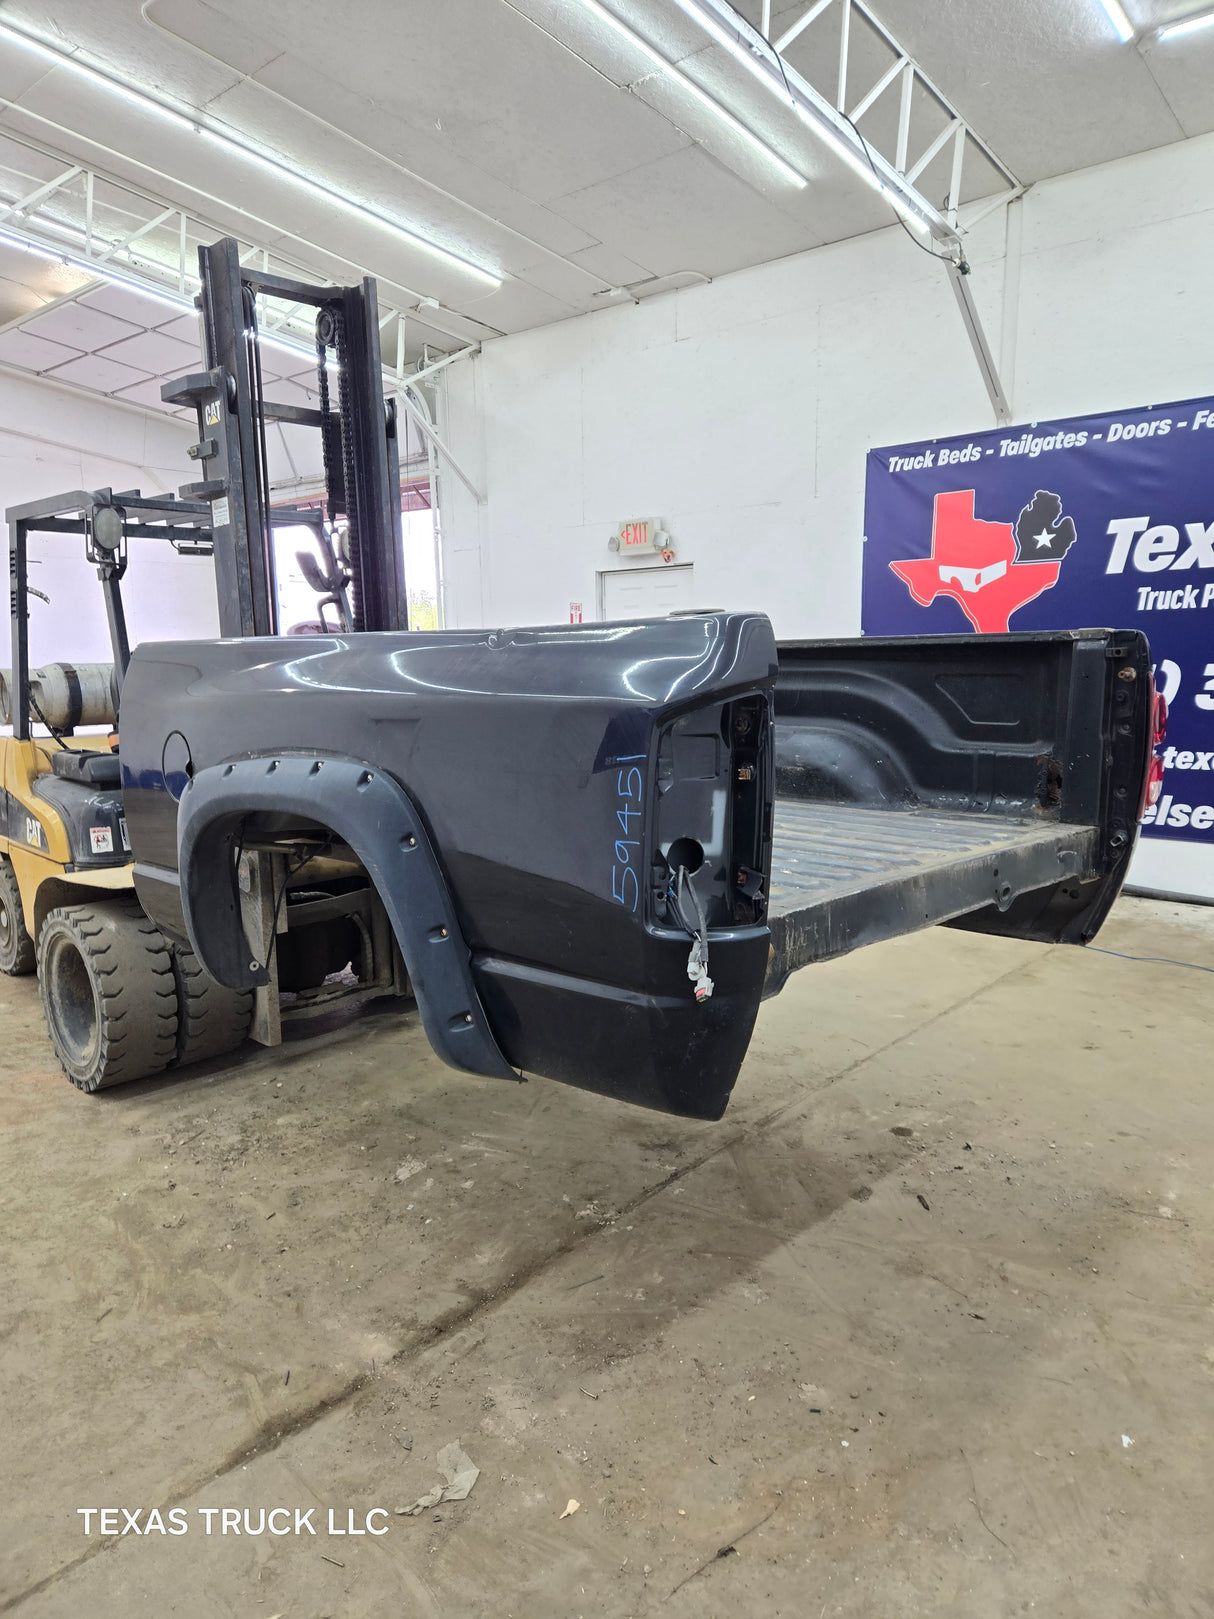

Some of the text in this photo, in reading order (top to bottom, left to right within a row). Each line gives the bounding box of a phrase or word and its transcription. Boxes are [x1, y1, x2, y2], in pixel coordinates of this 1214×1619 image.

[205, 400, 221, 425] CAT
[888, 450, 935, 472] Truck
[937, 444, 981, 466] Beds
[999, 430, 1088, 457] Tailgates
[1106, 419, 1172, 442] Doors
[625, 521, 649, 545] EXIT
[1105, 516, 1214, 574] Tex
[1137, 584, 1200, 610] Truck
[1162, 746, 1214, 771] tex
[26, 816, 42, 848] CAT
[612, 754, 647, 912] 59451
